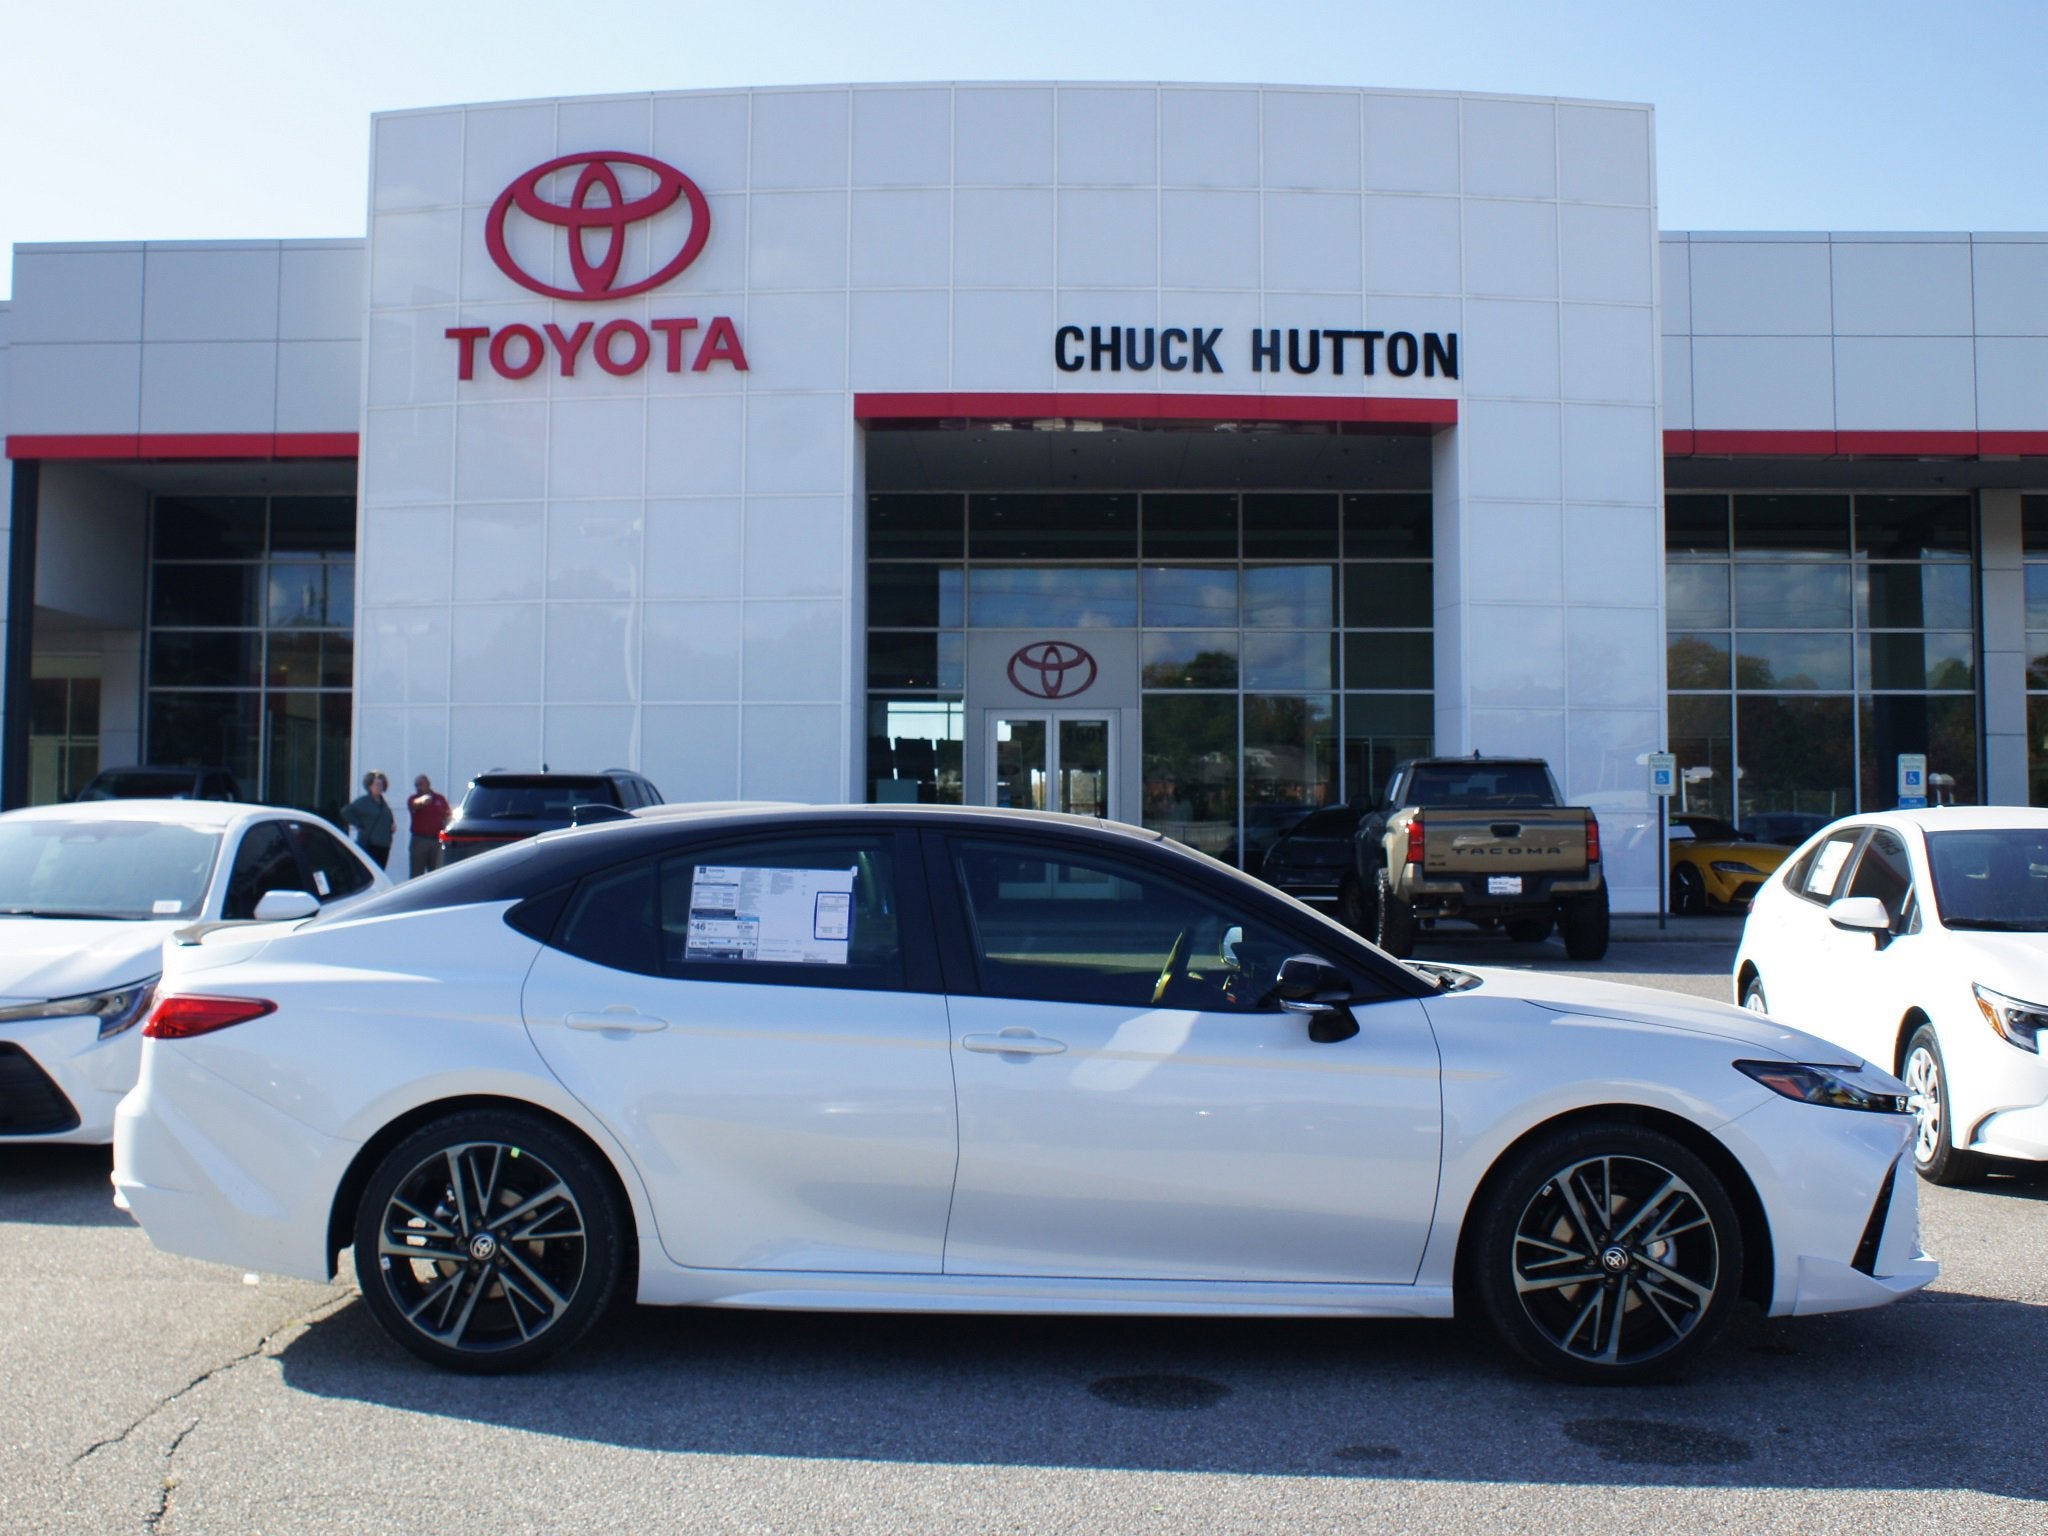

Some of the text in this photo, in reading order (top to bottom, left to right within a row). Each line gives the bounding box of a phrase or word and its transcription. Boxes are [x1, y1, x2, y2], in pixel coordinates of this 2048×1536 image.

[445, 317, 749, 380] TOYOTA
[1054, 326, 1459, 379] CHUCK HUTTON
[1452, 847, 1561, 855] TACOMA
